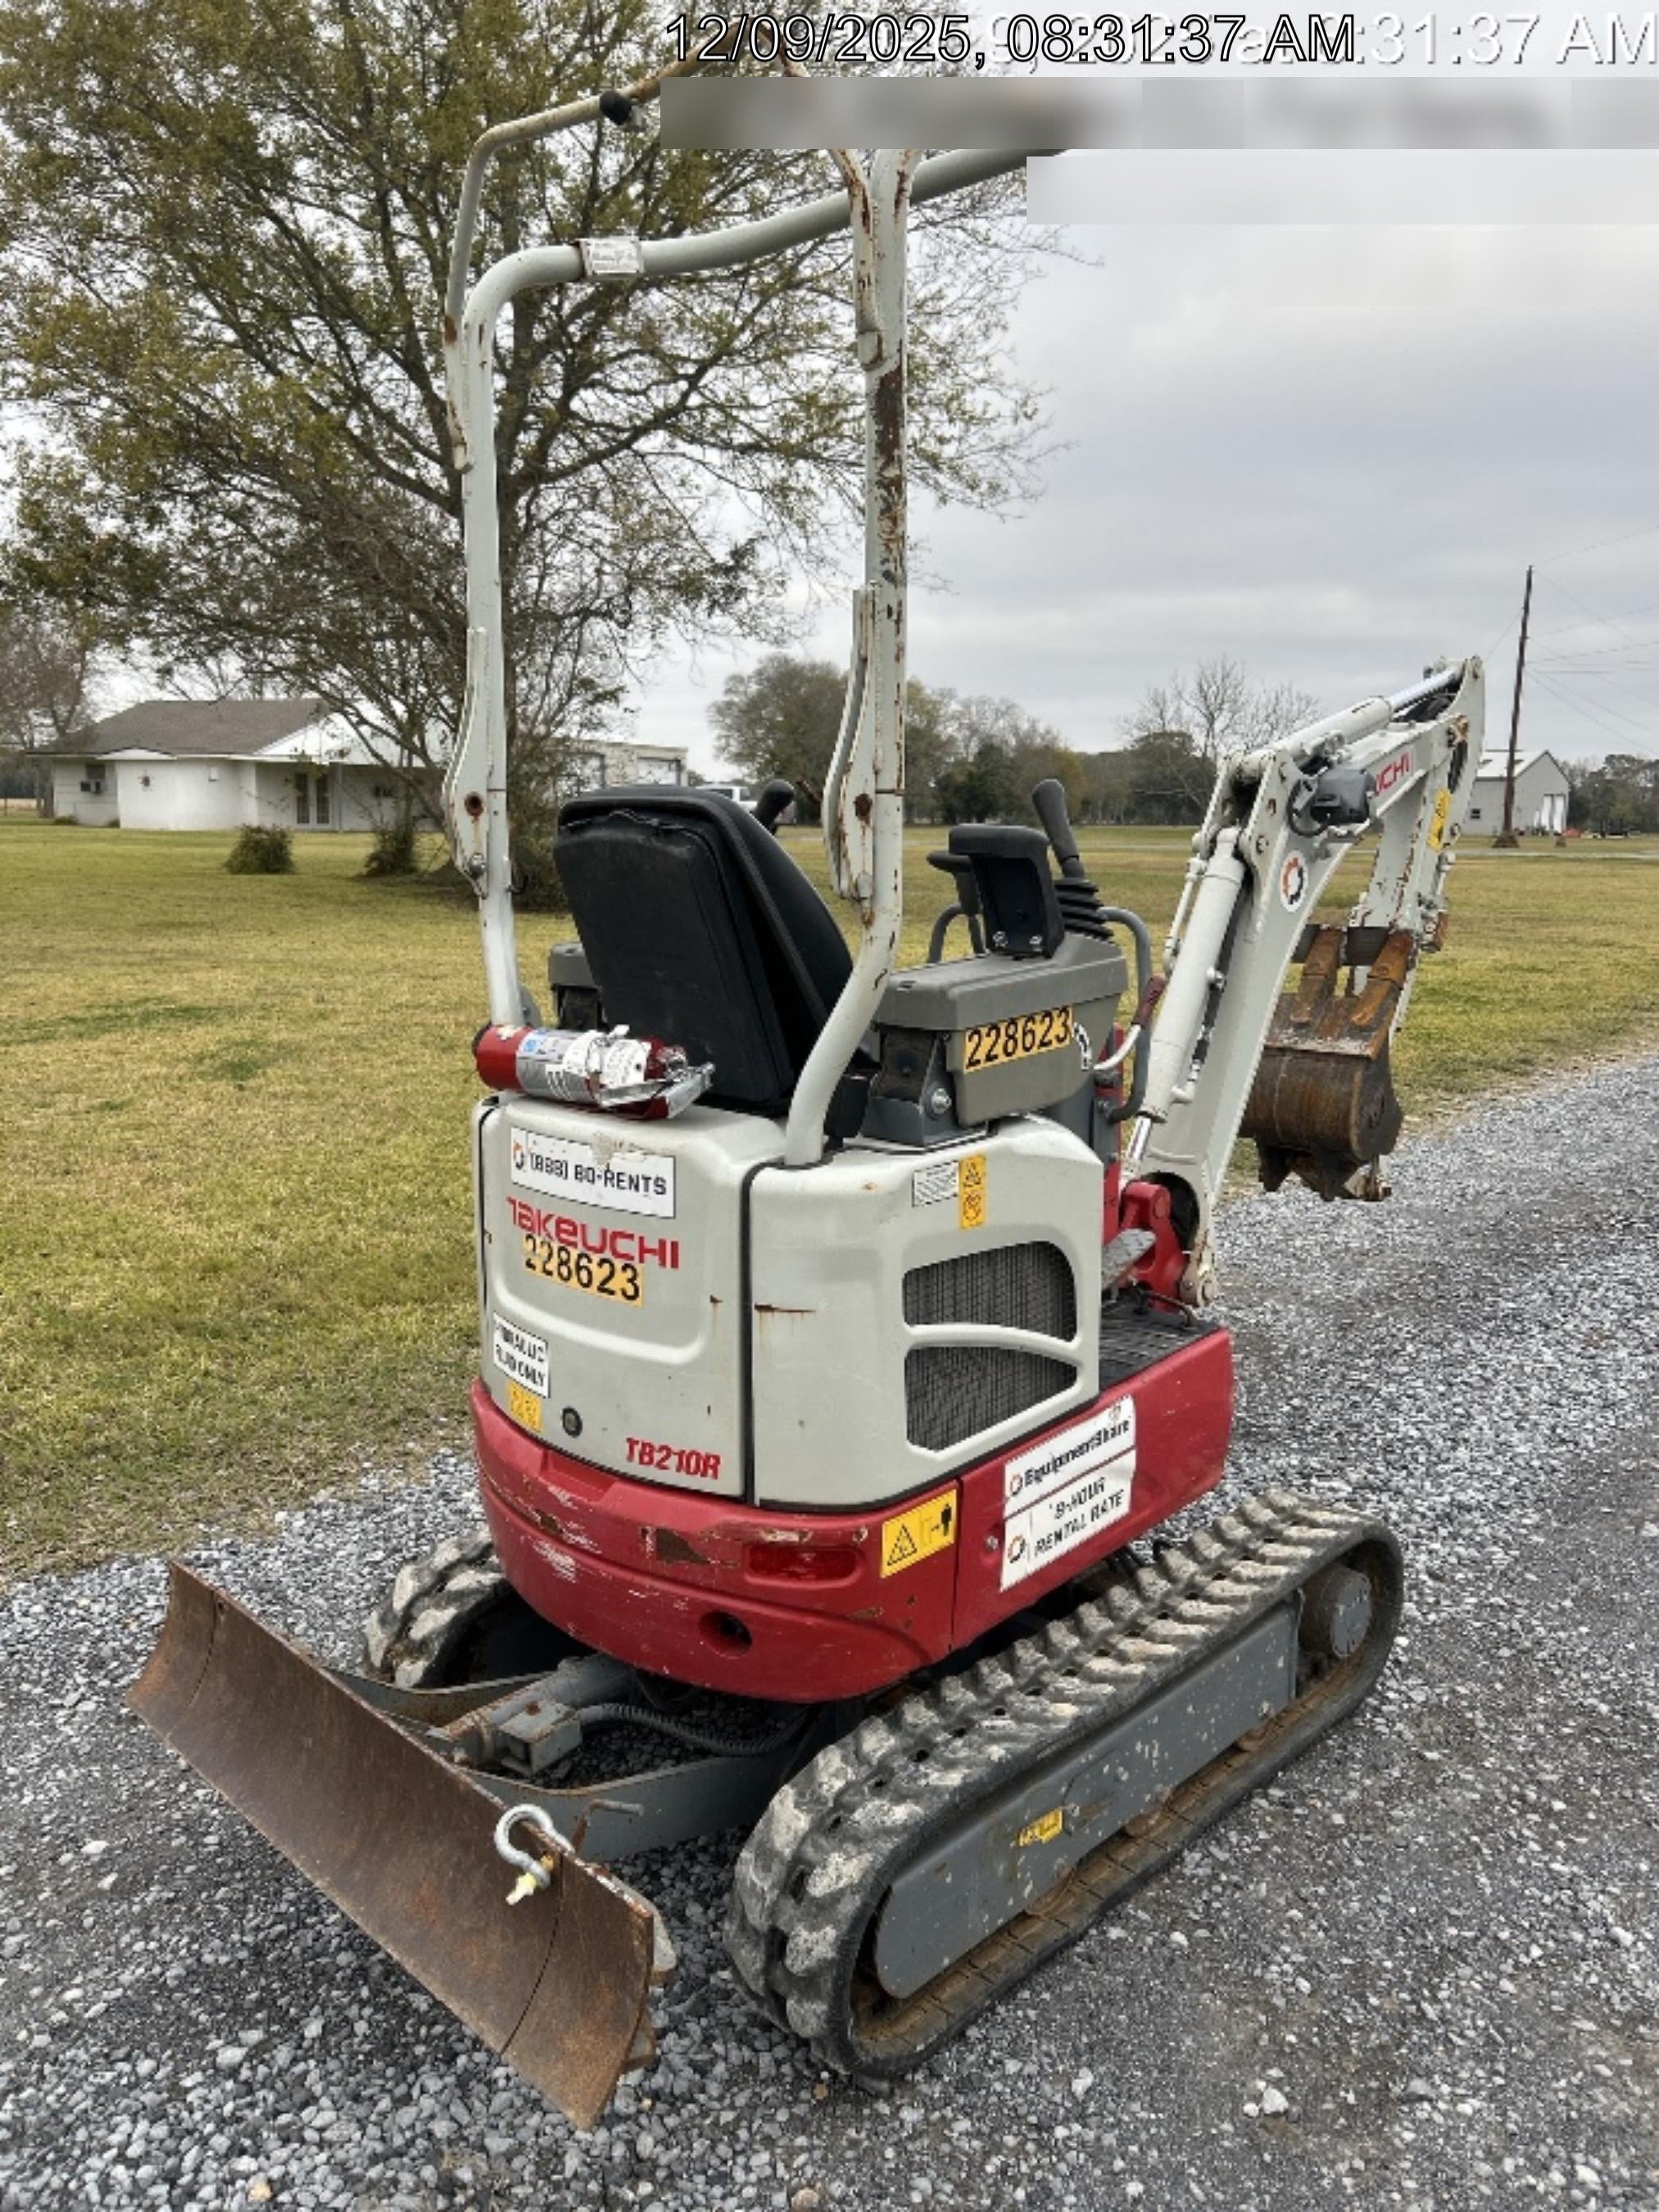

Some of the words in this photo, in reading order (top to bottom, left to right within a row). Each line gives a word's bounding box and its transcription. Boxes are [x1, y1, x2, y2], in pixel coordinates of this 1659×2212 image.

[966, 1006, 1070, 1069] 228623
[525, 1233, 640, 1301] 228623
[626, 1437, 722, 1480] TB210R
[1025, 1419, 1130, 1488] EquipmentShare
[1035, 1512, 1087, 1557] RENTAL
[1090, 1489, 1125, 1523] RATE
